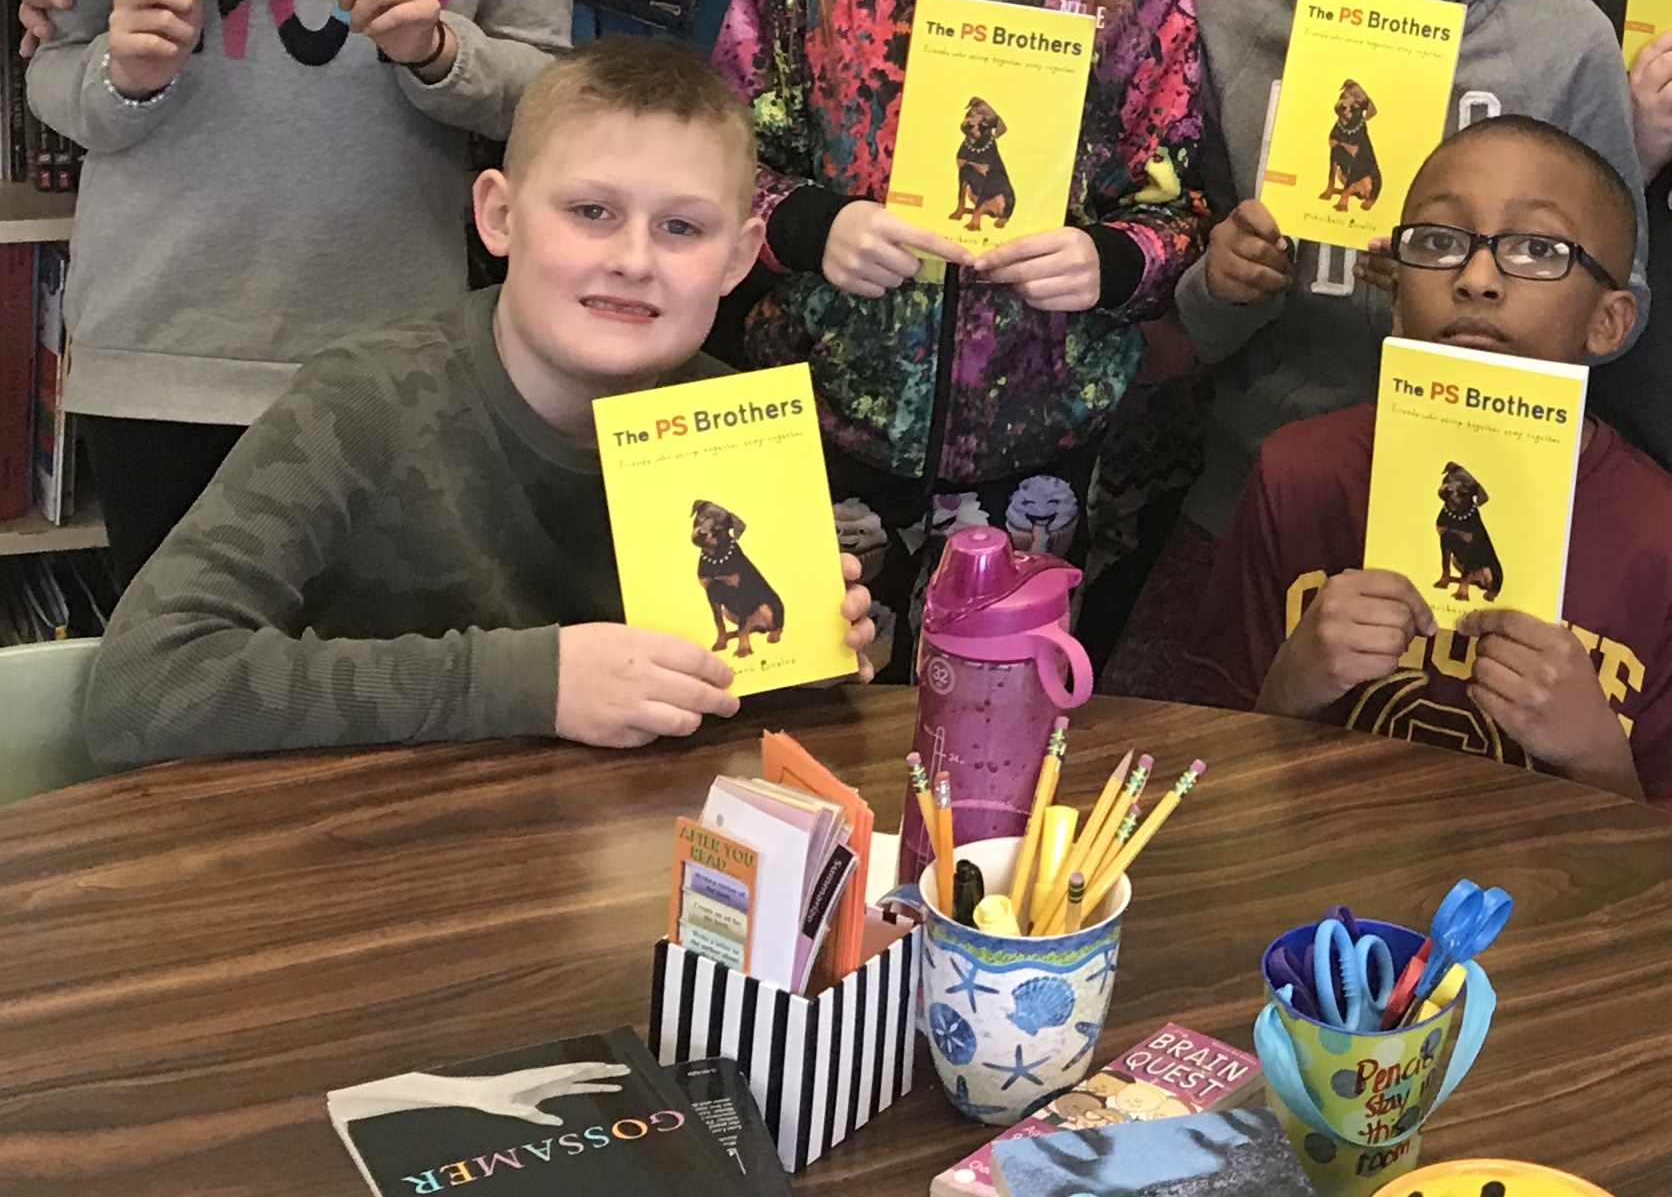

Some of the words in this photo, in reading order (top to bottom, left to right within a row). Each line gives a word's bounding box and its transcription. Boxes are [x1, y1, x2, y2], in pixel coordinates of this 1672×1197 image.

[926, 20, 955, 37] The
[960, 22, 987, 42] PS
[992, 26, 1082, 56] Brothers
[1308, 5, 1334, 21] The
[1338, 6, 1363, 26] PS
[1367, 10, 1450, 41] Brothers
[1393, 377, 1424, 397] The
[1430, 381, 1459, 404] PS
[1465, 387, 1567, 424] Brothers
[612, 430, 649, 446] The
[655, 415, 688, 439] PS
[693, 398, 803, 432] Brothers
[932, 666, 948, 683] 32
[724, 843, 754, 867] YOU
[806, 859, 842, 923] Summarize
[1125, 1050, 1224, 1098] QUEST
[1148, 1032, 1249, 1082] BRAIN
[1364, 1088, 1411, 1119] stay
[401, 1110, 685, 1195] GOSSAMER
[1355, 1138, 1411, 1176] room
